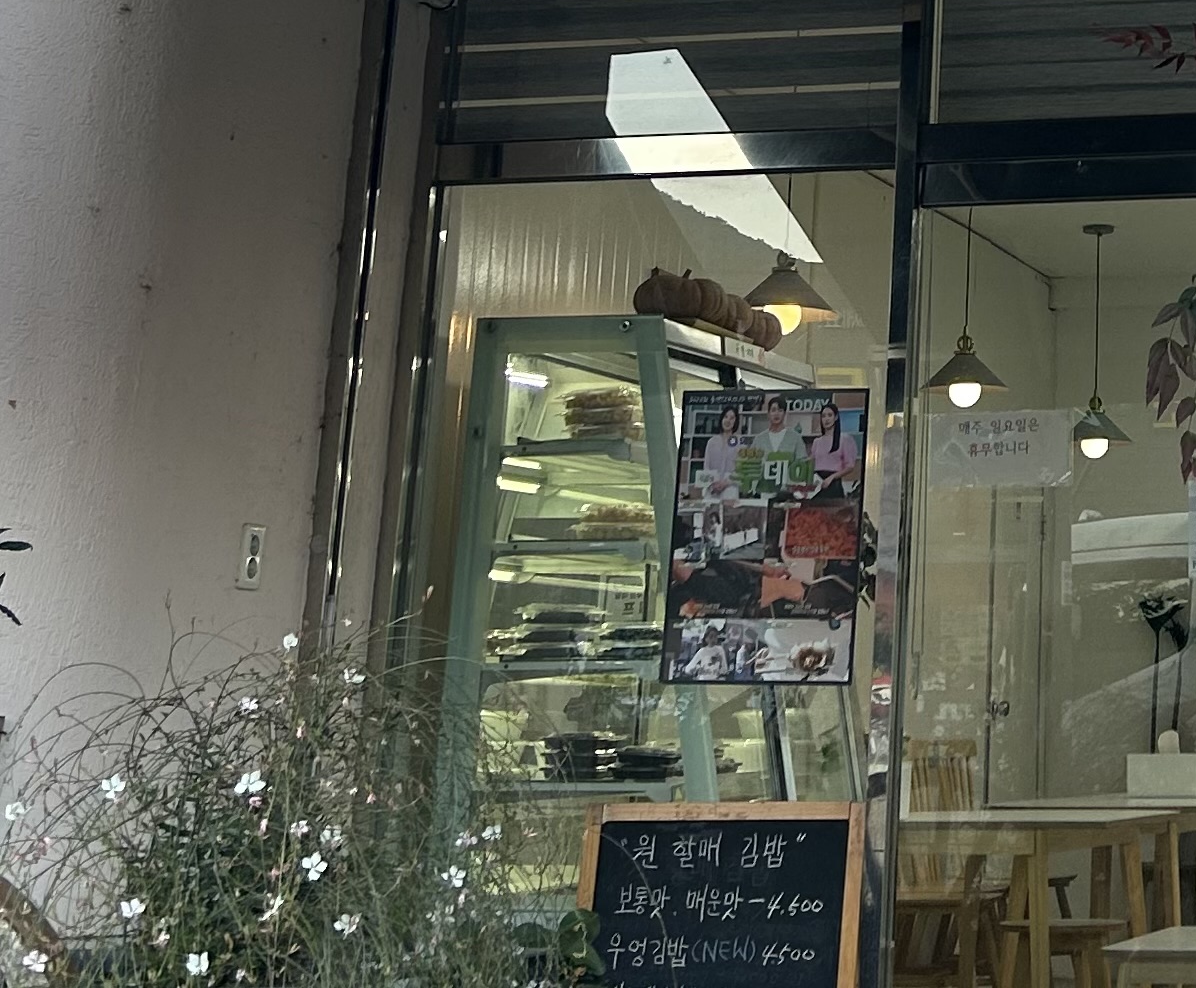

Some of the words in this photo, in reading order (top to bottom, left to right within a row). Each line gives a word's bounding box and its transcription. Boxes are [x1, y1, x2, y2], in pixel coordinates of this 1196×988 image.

[785, 398, 831, 413] TODAY
[958, 420, 983, 436] 매주
[989, 417, 1040, 434] 일요일은
[967, 439, 1030, 458] 휴무합니다
[671, 830, 724, 869] 할매
